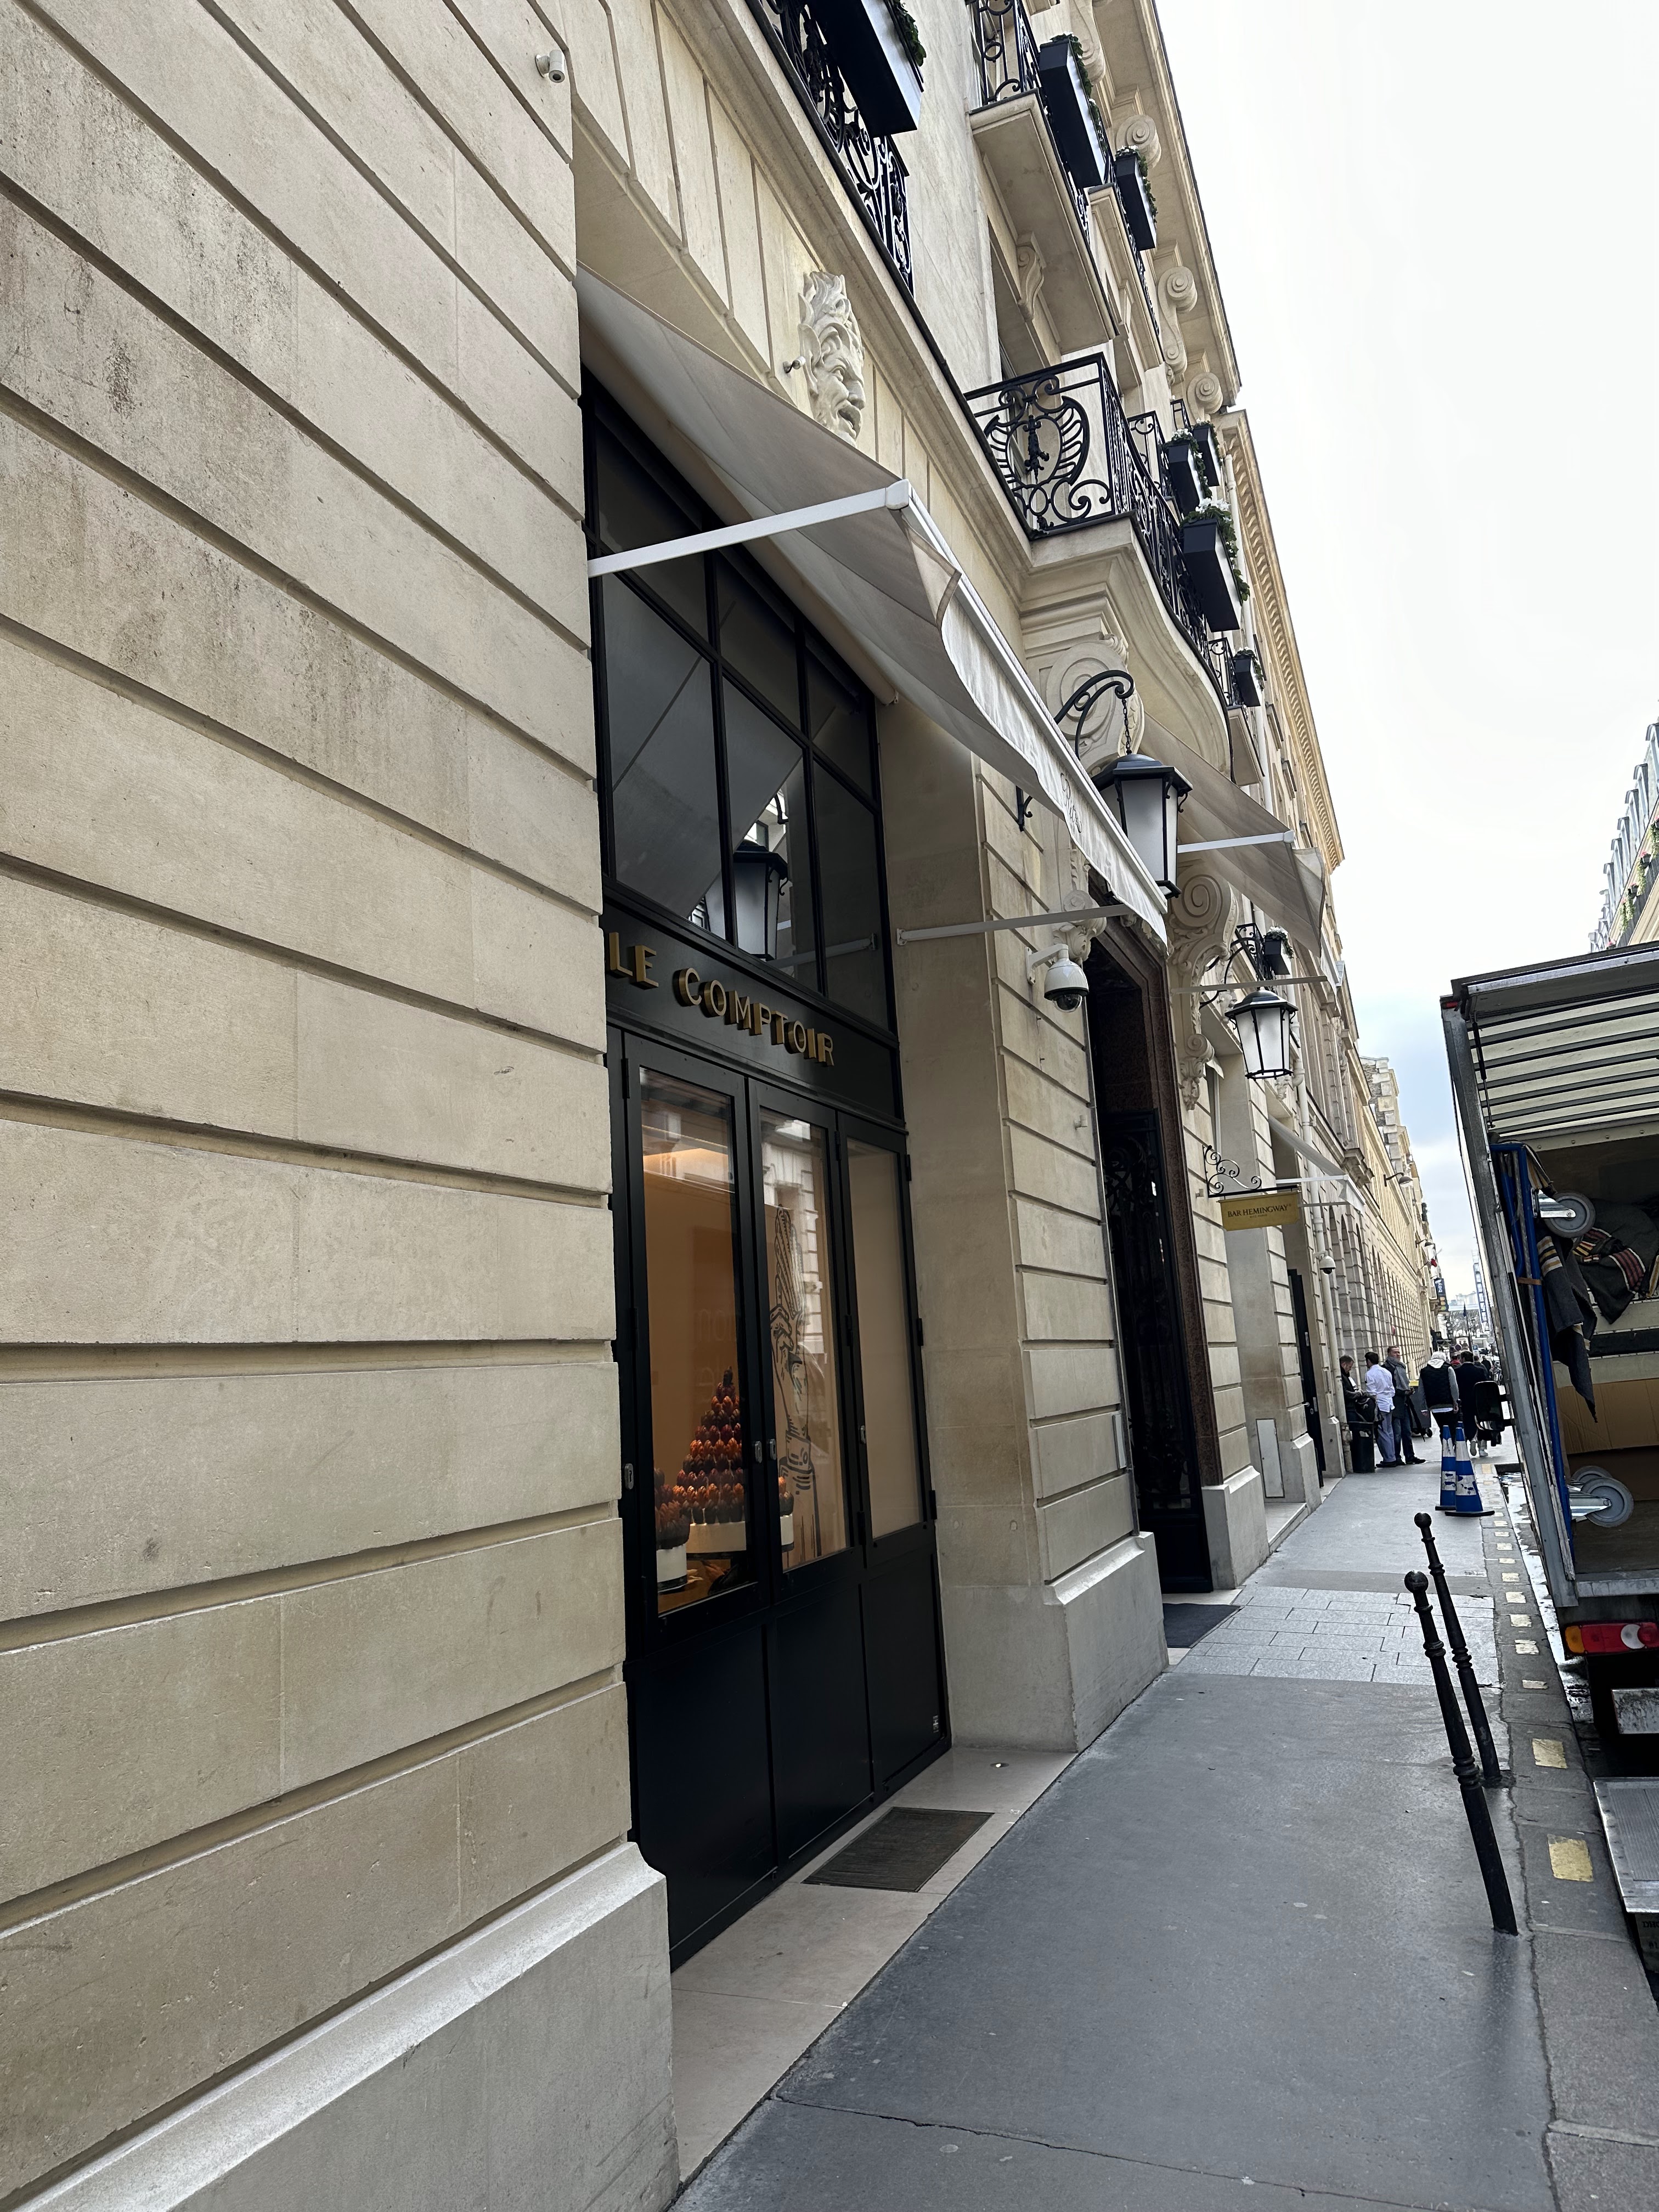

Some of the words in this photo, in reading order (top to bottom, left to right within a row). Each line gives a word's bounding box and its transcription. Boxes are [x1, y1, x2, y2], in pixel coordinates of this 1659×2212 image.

[608, 932, 659, 989] LE
[677, 967, 834, 1067] COMPTOIR
[1243, 1204, 1288, 1216] HEMINGWAY
